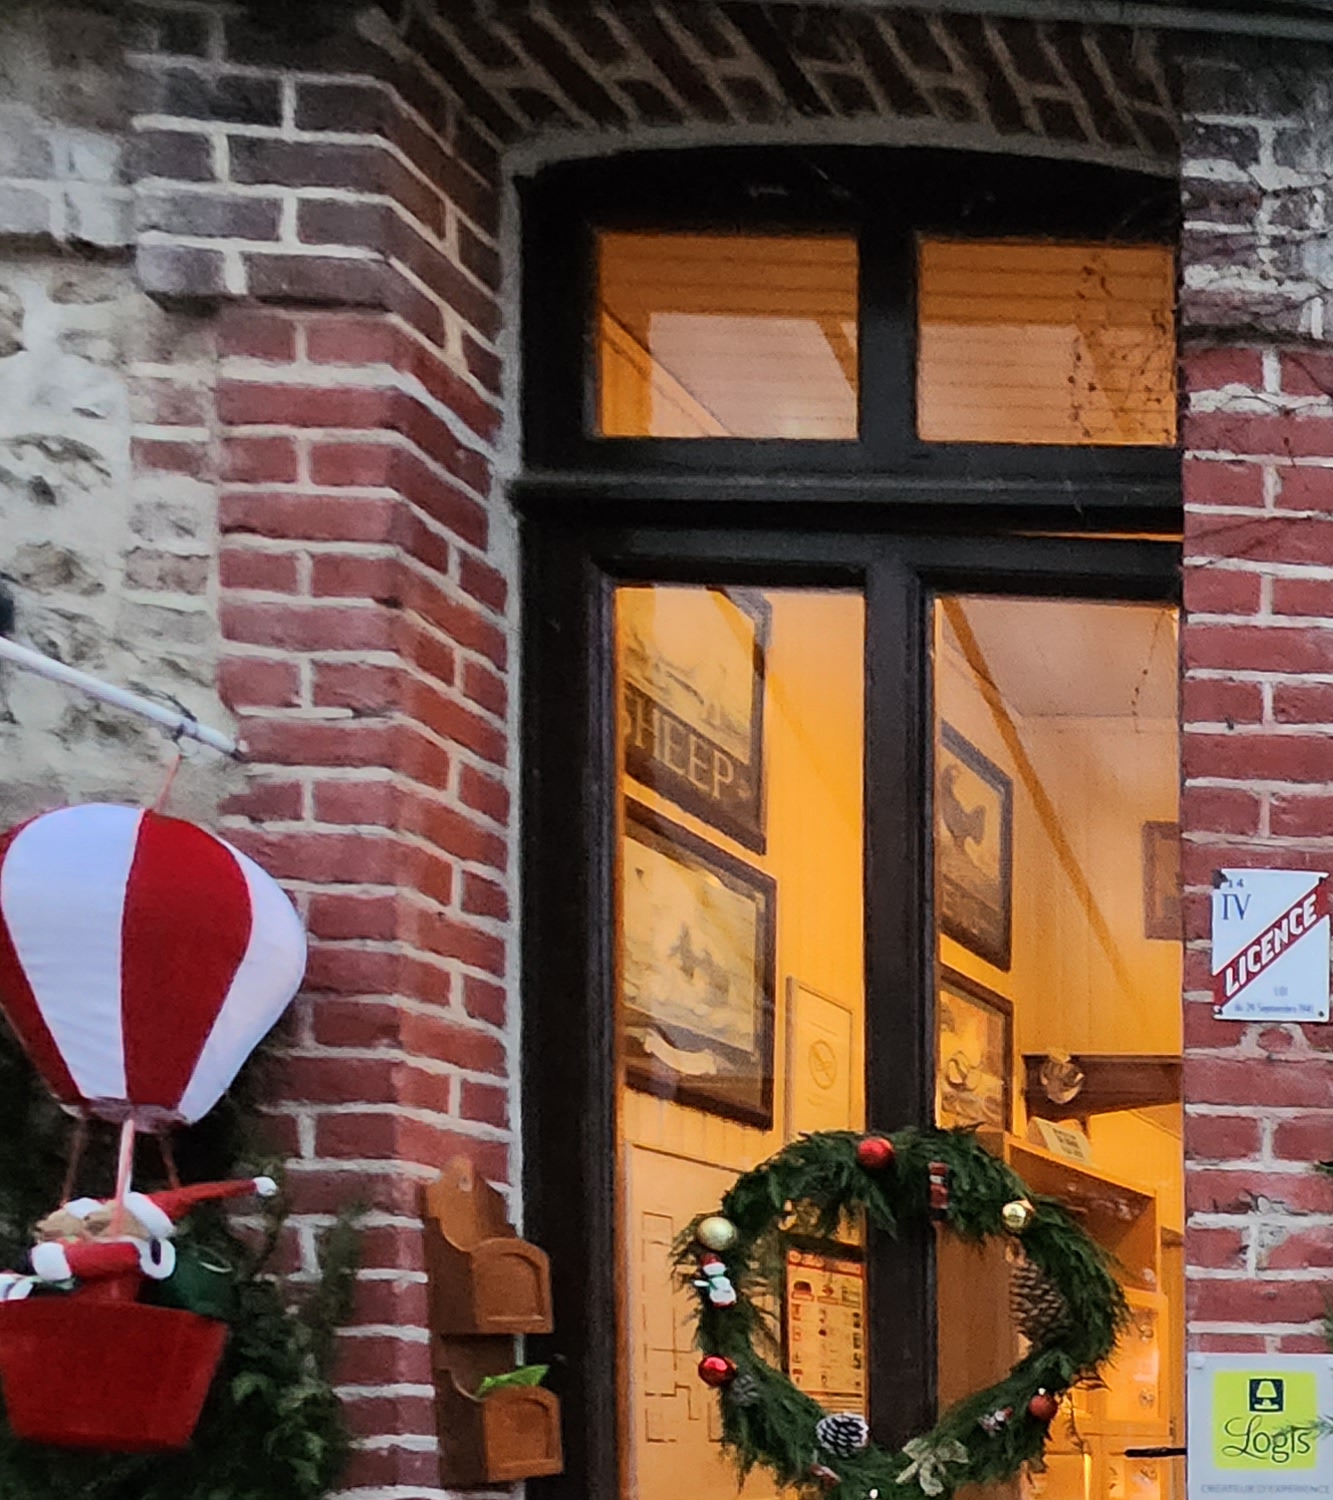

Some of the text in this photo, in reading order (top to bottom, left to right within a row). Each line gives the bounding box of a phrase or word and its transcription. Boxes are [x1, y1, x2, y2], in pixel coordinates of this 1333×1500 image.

[1222, 893, 1251, 920] IV
[1225, 894, 1317, 997] LICENCE
[1221, 1414, 1311, 1464] Logis
